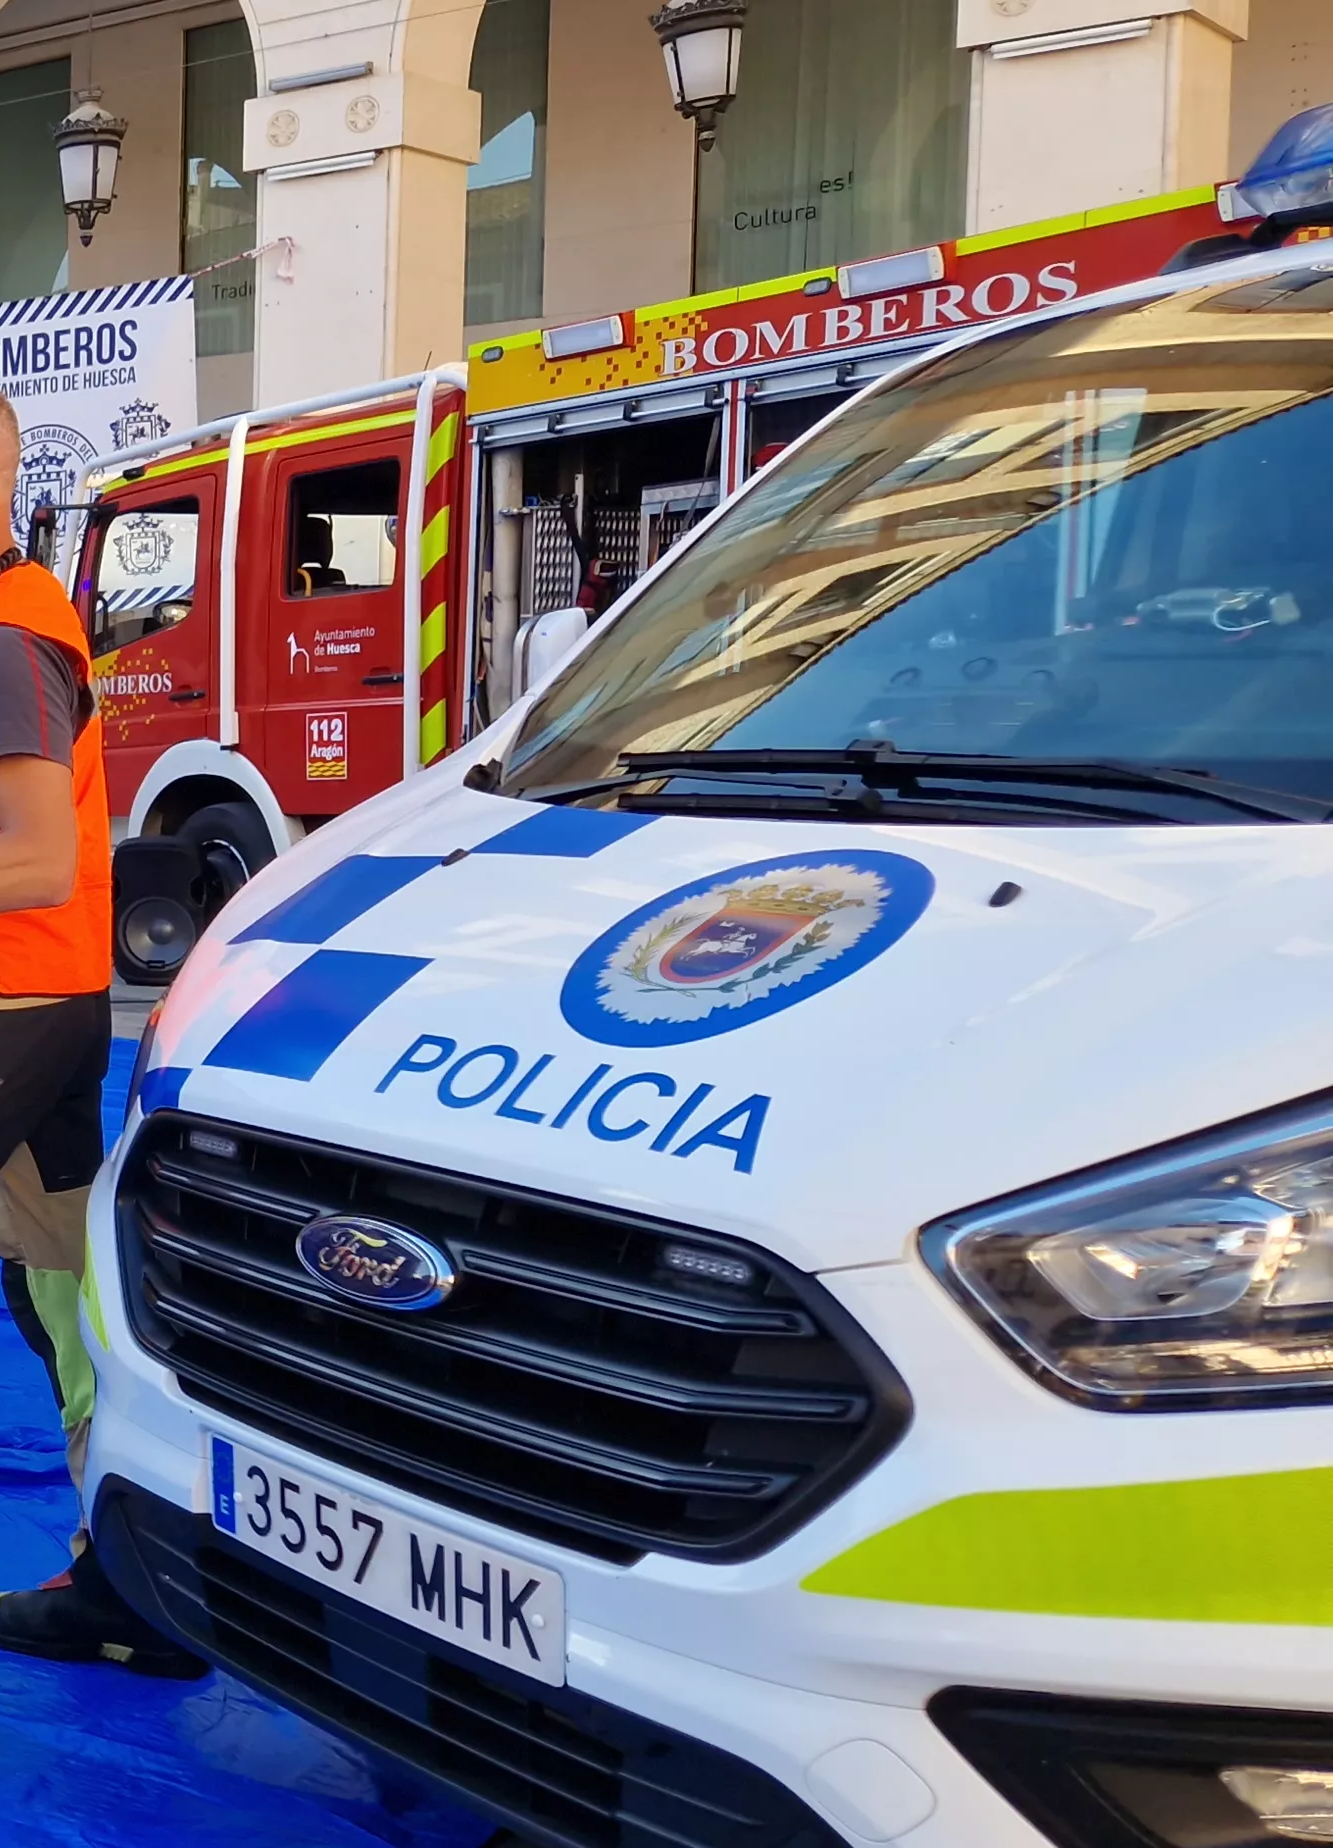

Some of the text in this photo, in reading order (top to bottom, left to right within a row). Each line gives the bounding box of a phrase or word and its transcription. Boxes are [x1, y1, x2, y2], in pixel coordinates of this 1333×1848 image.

[734, 206, 817, 231] Cultura
[211, 280, 255, 300] Tradi
[659, 260, 1079, 377] BOMBEROS
[63, 373, 80, 393] DE
[83, 366, 137, 390] HUESCA
[30, 428, 79, 446] BOMBEROS
[313, 625, 376, 643] Ayuntamiento
[313, 642, 361, 657] de Huesca
[310, 717, 344, 742] 112
[310, 743, 344, 761] Aragón
[373, 1033, 773, 1176] POLICIA
[317, 1228, 407, 1289] Ford
[219, 1465, 542, 1663] E 3557 MHK
